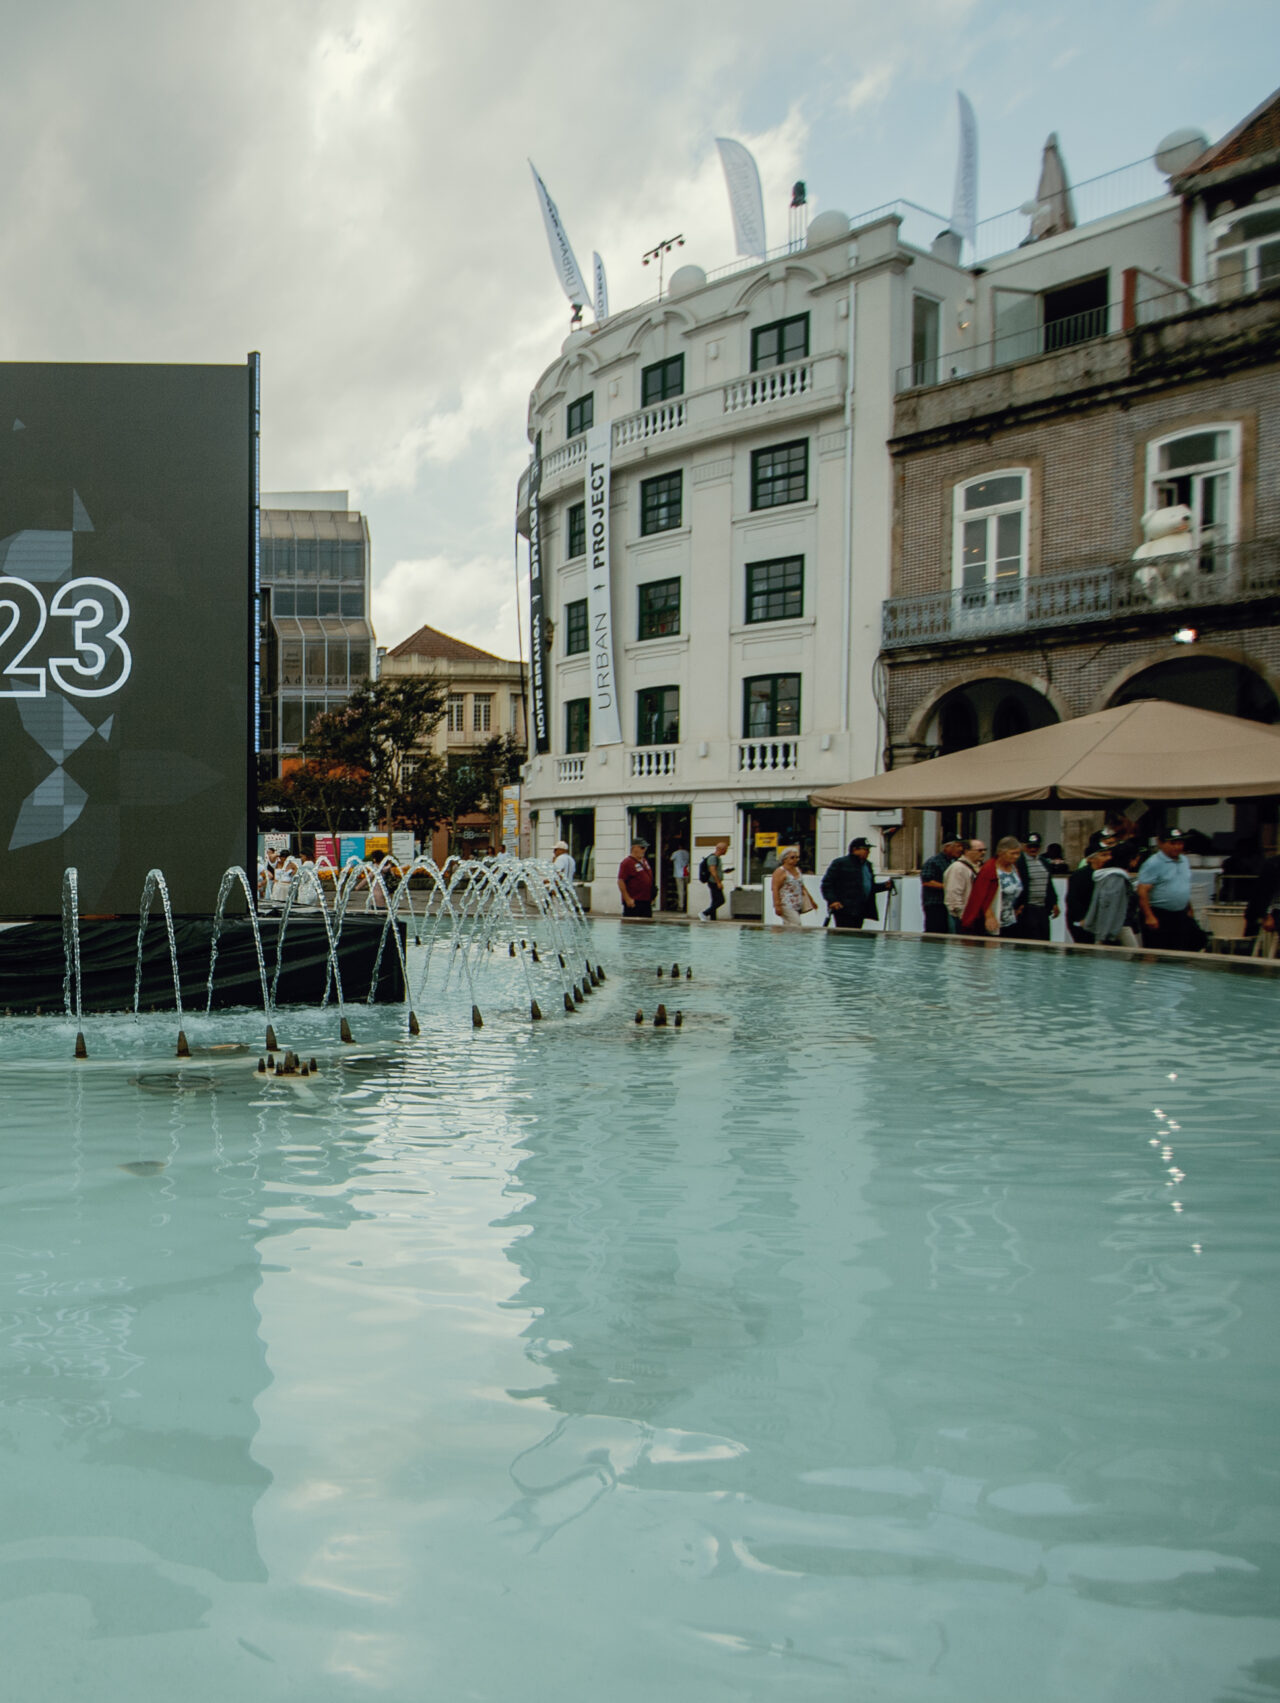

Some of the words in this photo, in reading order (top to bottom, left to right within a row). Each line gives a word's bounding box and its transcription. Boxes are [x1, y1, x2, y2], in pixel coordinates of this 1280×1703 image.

[591, 462, 605, 570] PROJECT
[283, 675, 359, 687] Advogado
[595, 612, 612, 710] URBAN
[535, 687, 545, 739] NOITE
